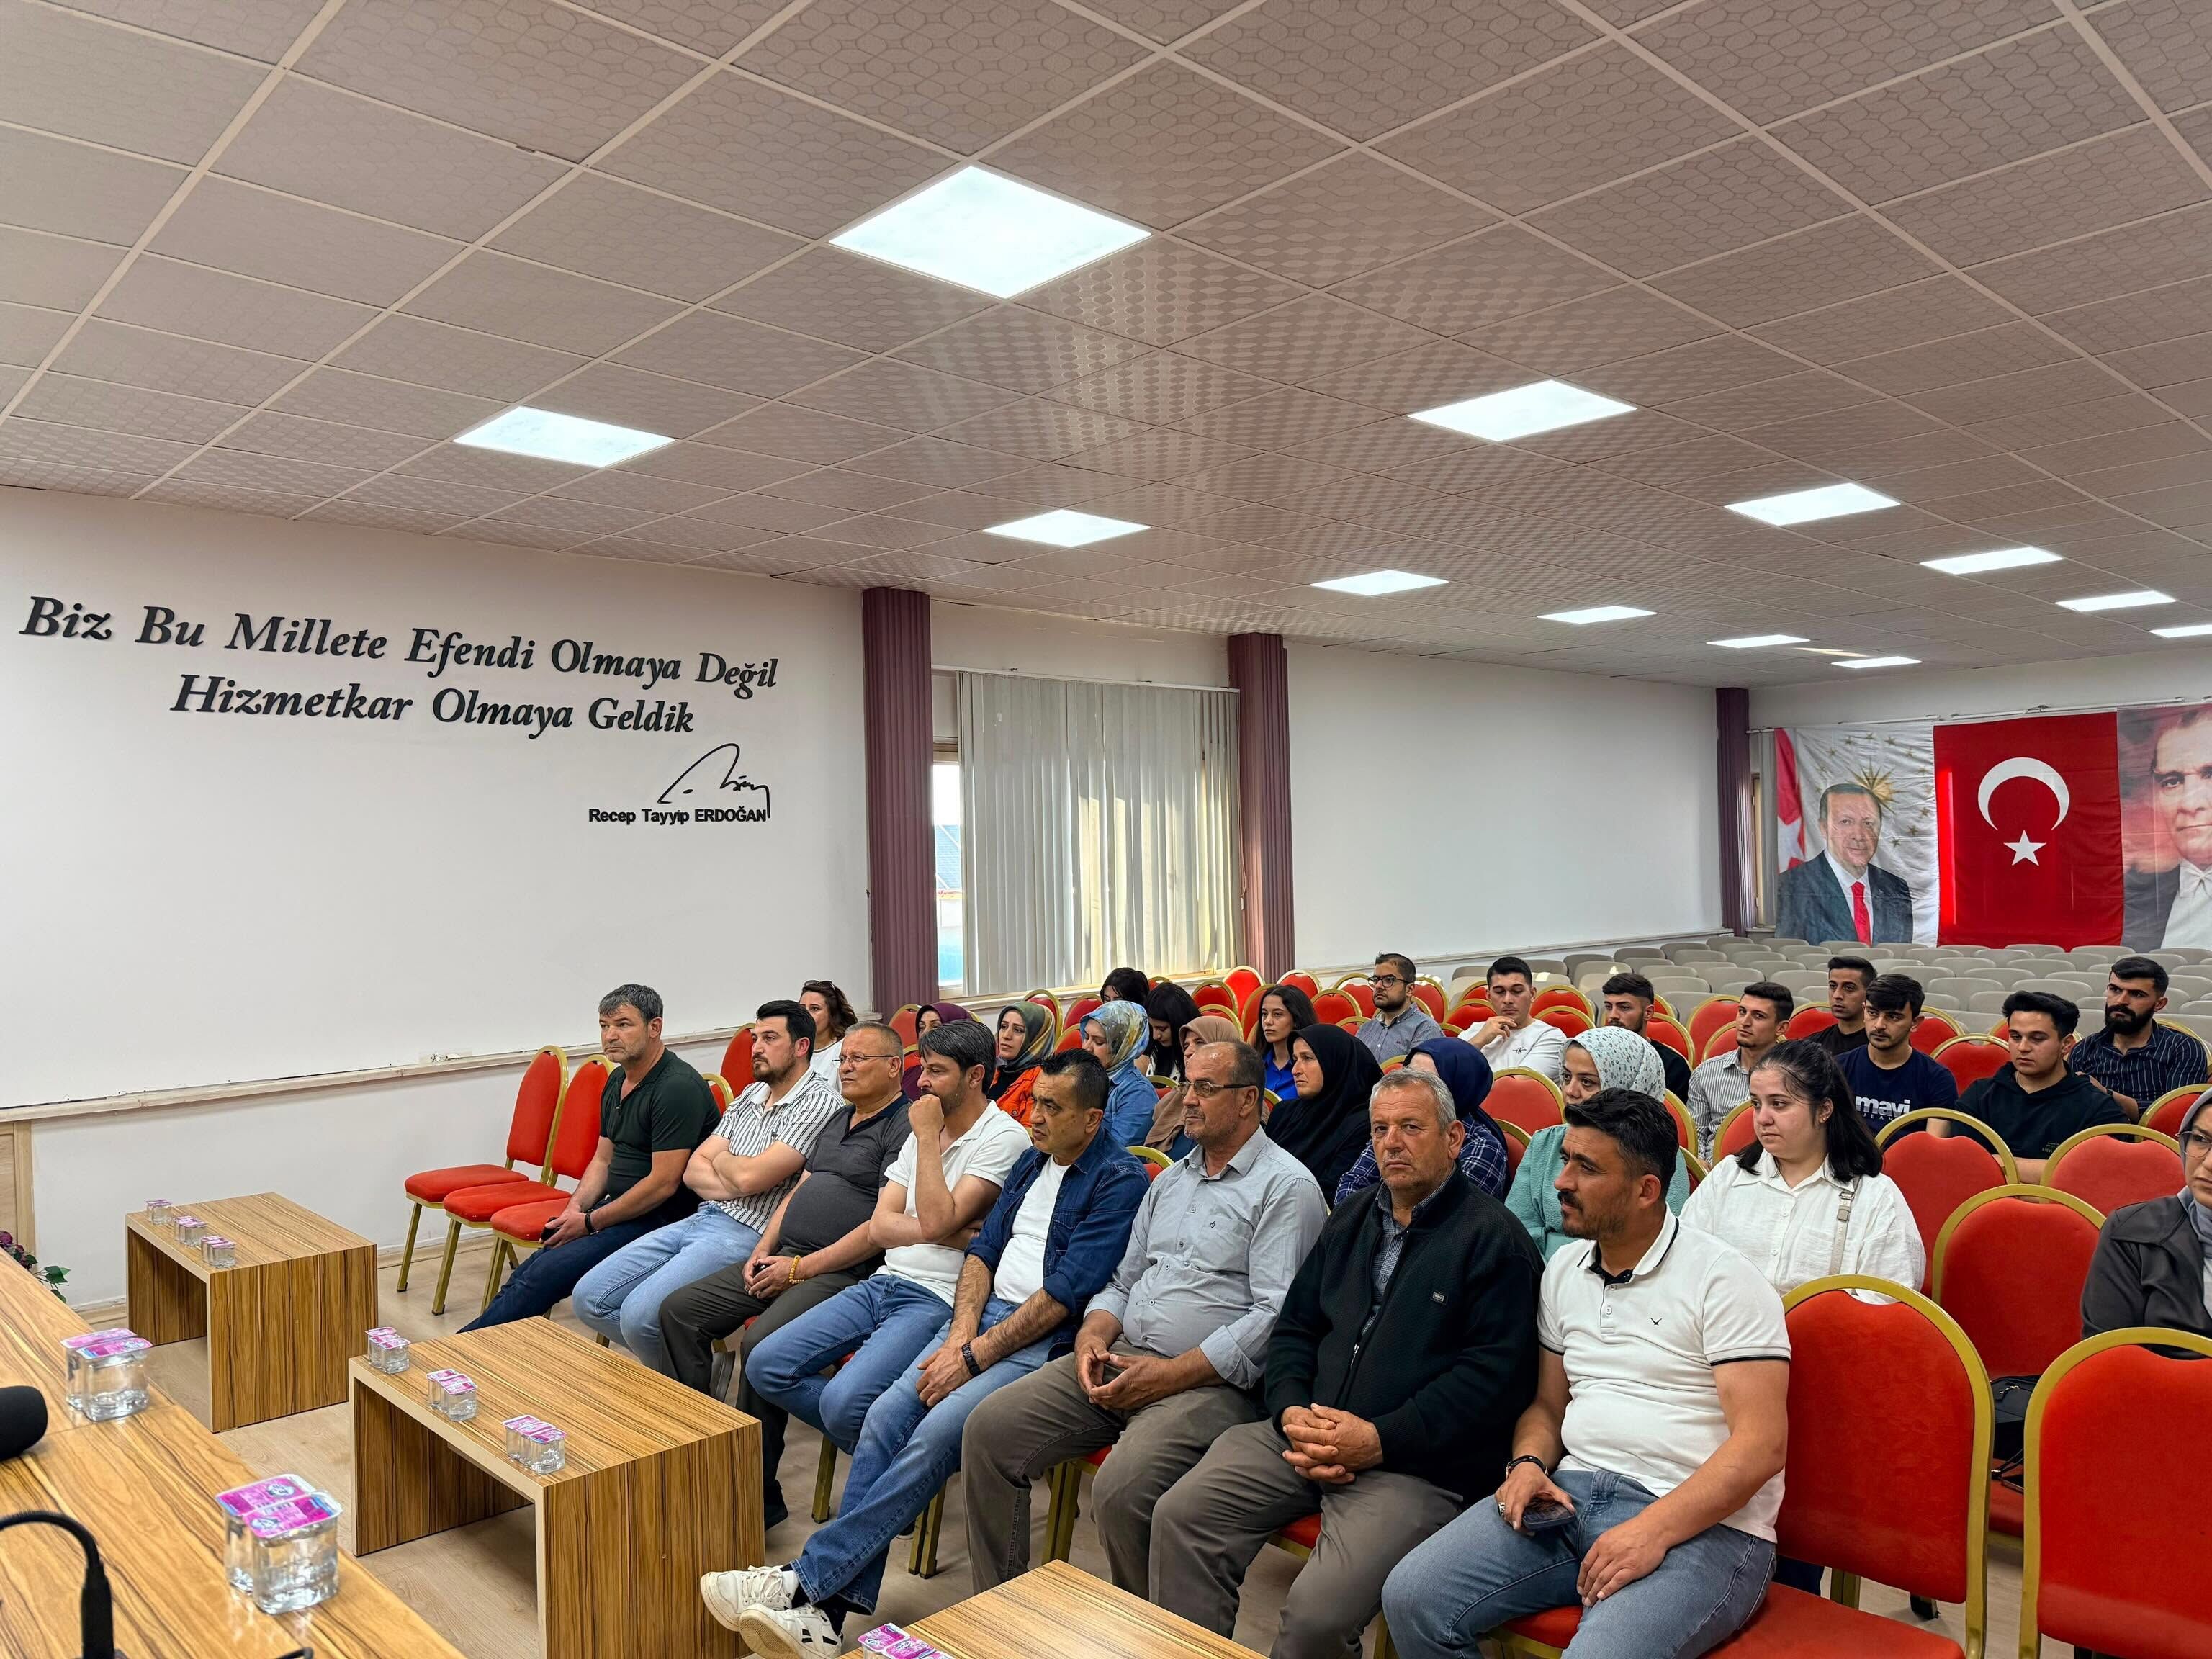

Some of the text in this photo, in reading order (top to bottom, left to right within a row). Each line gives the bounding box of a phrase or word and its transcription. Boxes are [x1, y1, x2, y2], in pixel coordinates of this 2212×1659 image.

[19, 595, 778, 700] Biz Bu Millete Efendi Olmaya Değil
[169, 674, 694, 740] Hizmetkar Olmaya Geldik
[588, 806, 767, 826] Recep Tayyip ERDOĞAN
[1855, 1095, 1911, 1118] mavi
[1863, 1112, 1894, 1121] JEAN
